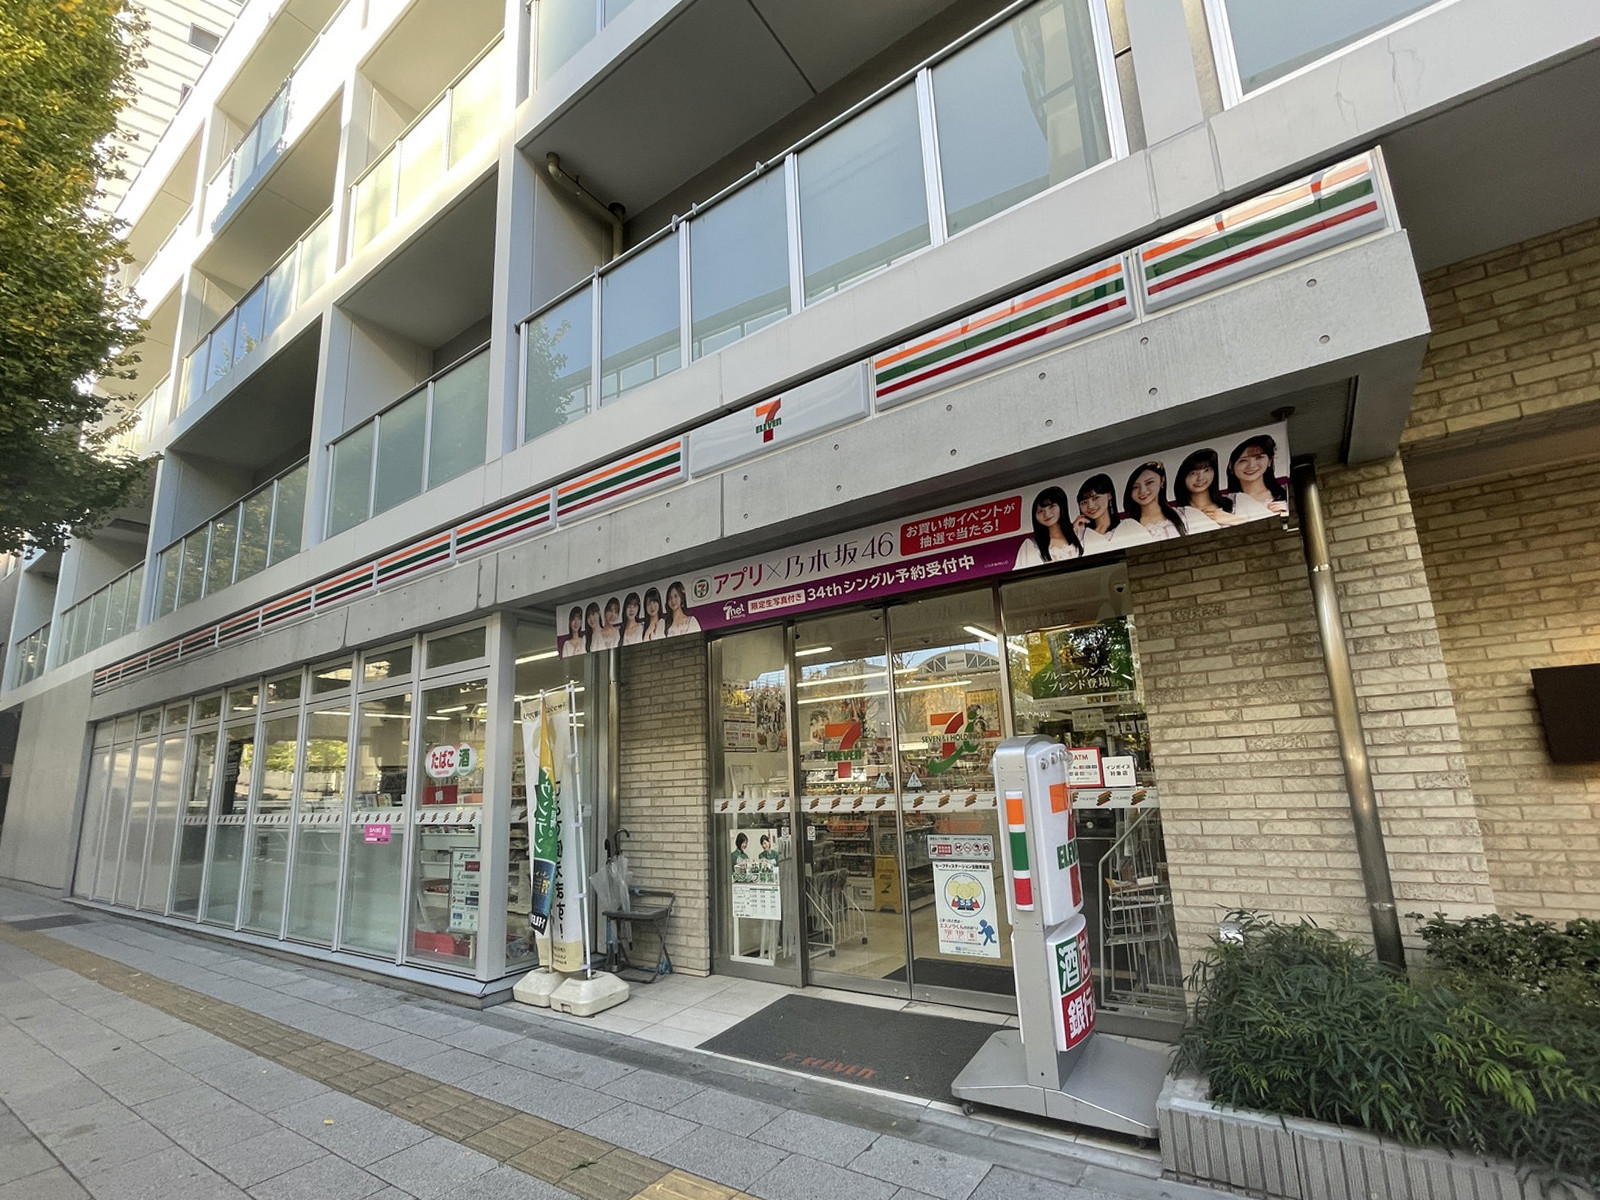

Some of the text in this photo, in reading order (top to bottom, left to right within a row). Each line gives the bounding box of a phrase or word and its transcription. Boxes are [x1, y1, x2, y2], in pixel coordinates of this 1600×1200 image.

[906, 502, 1016, 538] お買い物イベントが
[750, 594, 802, 611] 限定生写真付き
[431, 750, 455, 769] たばこ
[458, 748, 470, 767] 酒
[1058, 941, 1080, 991] 酒
